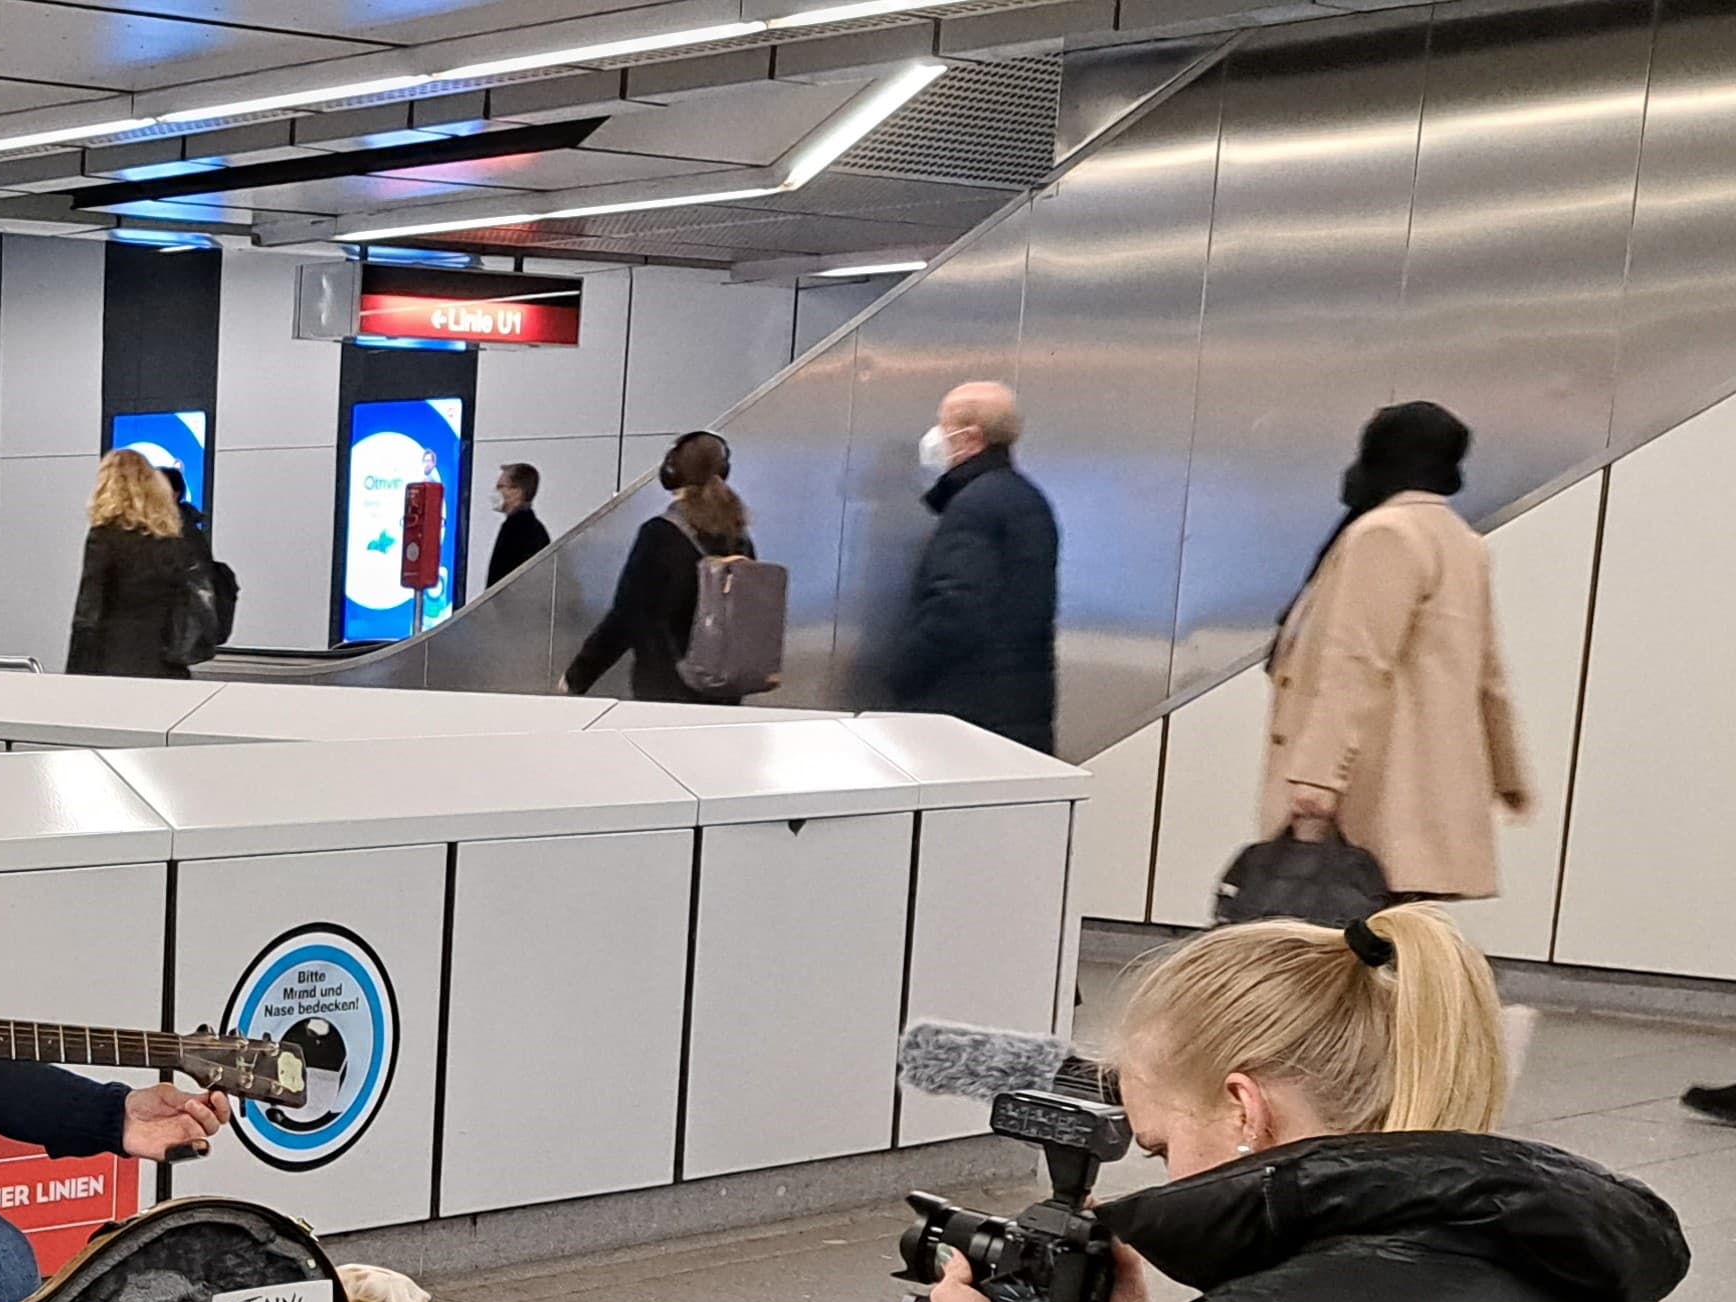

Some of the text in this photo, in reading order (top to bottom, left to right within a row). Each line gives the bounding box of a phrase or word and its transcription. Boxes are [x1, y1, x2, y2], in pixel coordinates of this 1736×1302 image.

[448, 308, 523, 335] Linie U1
[297, 970, 326, 984] Bitte
[282, 984, 343, 1000] Mund und
[264, 998, 360, 1018] Nase bedecken!
[36, 1175, 105, 1204] LINIEN
